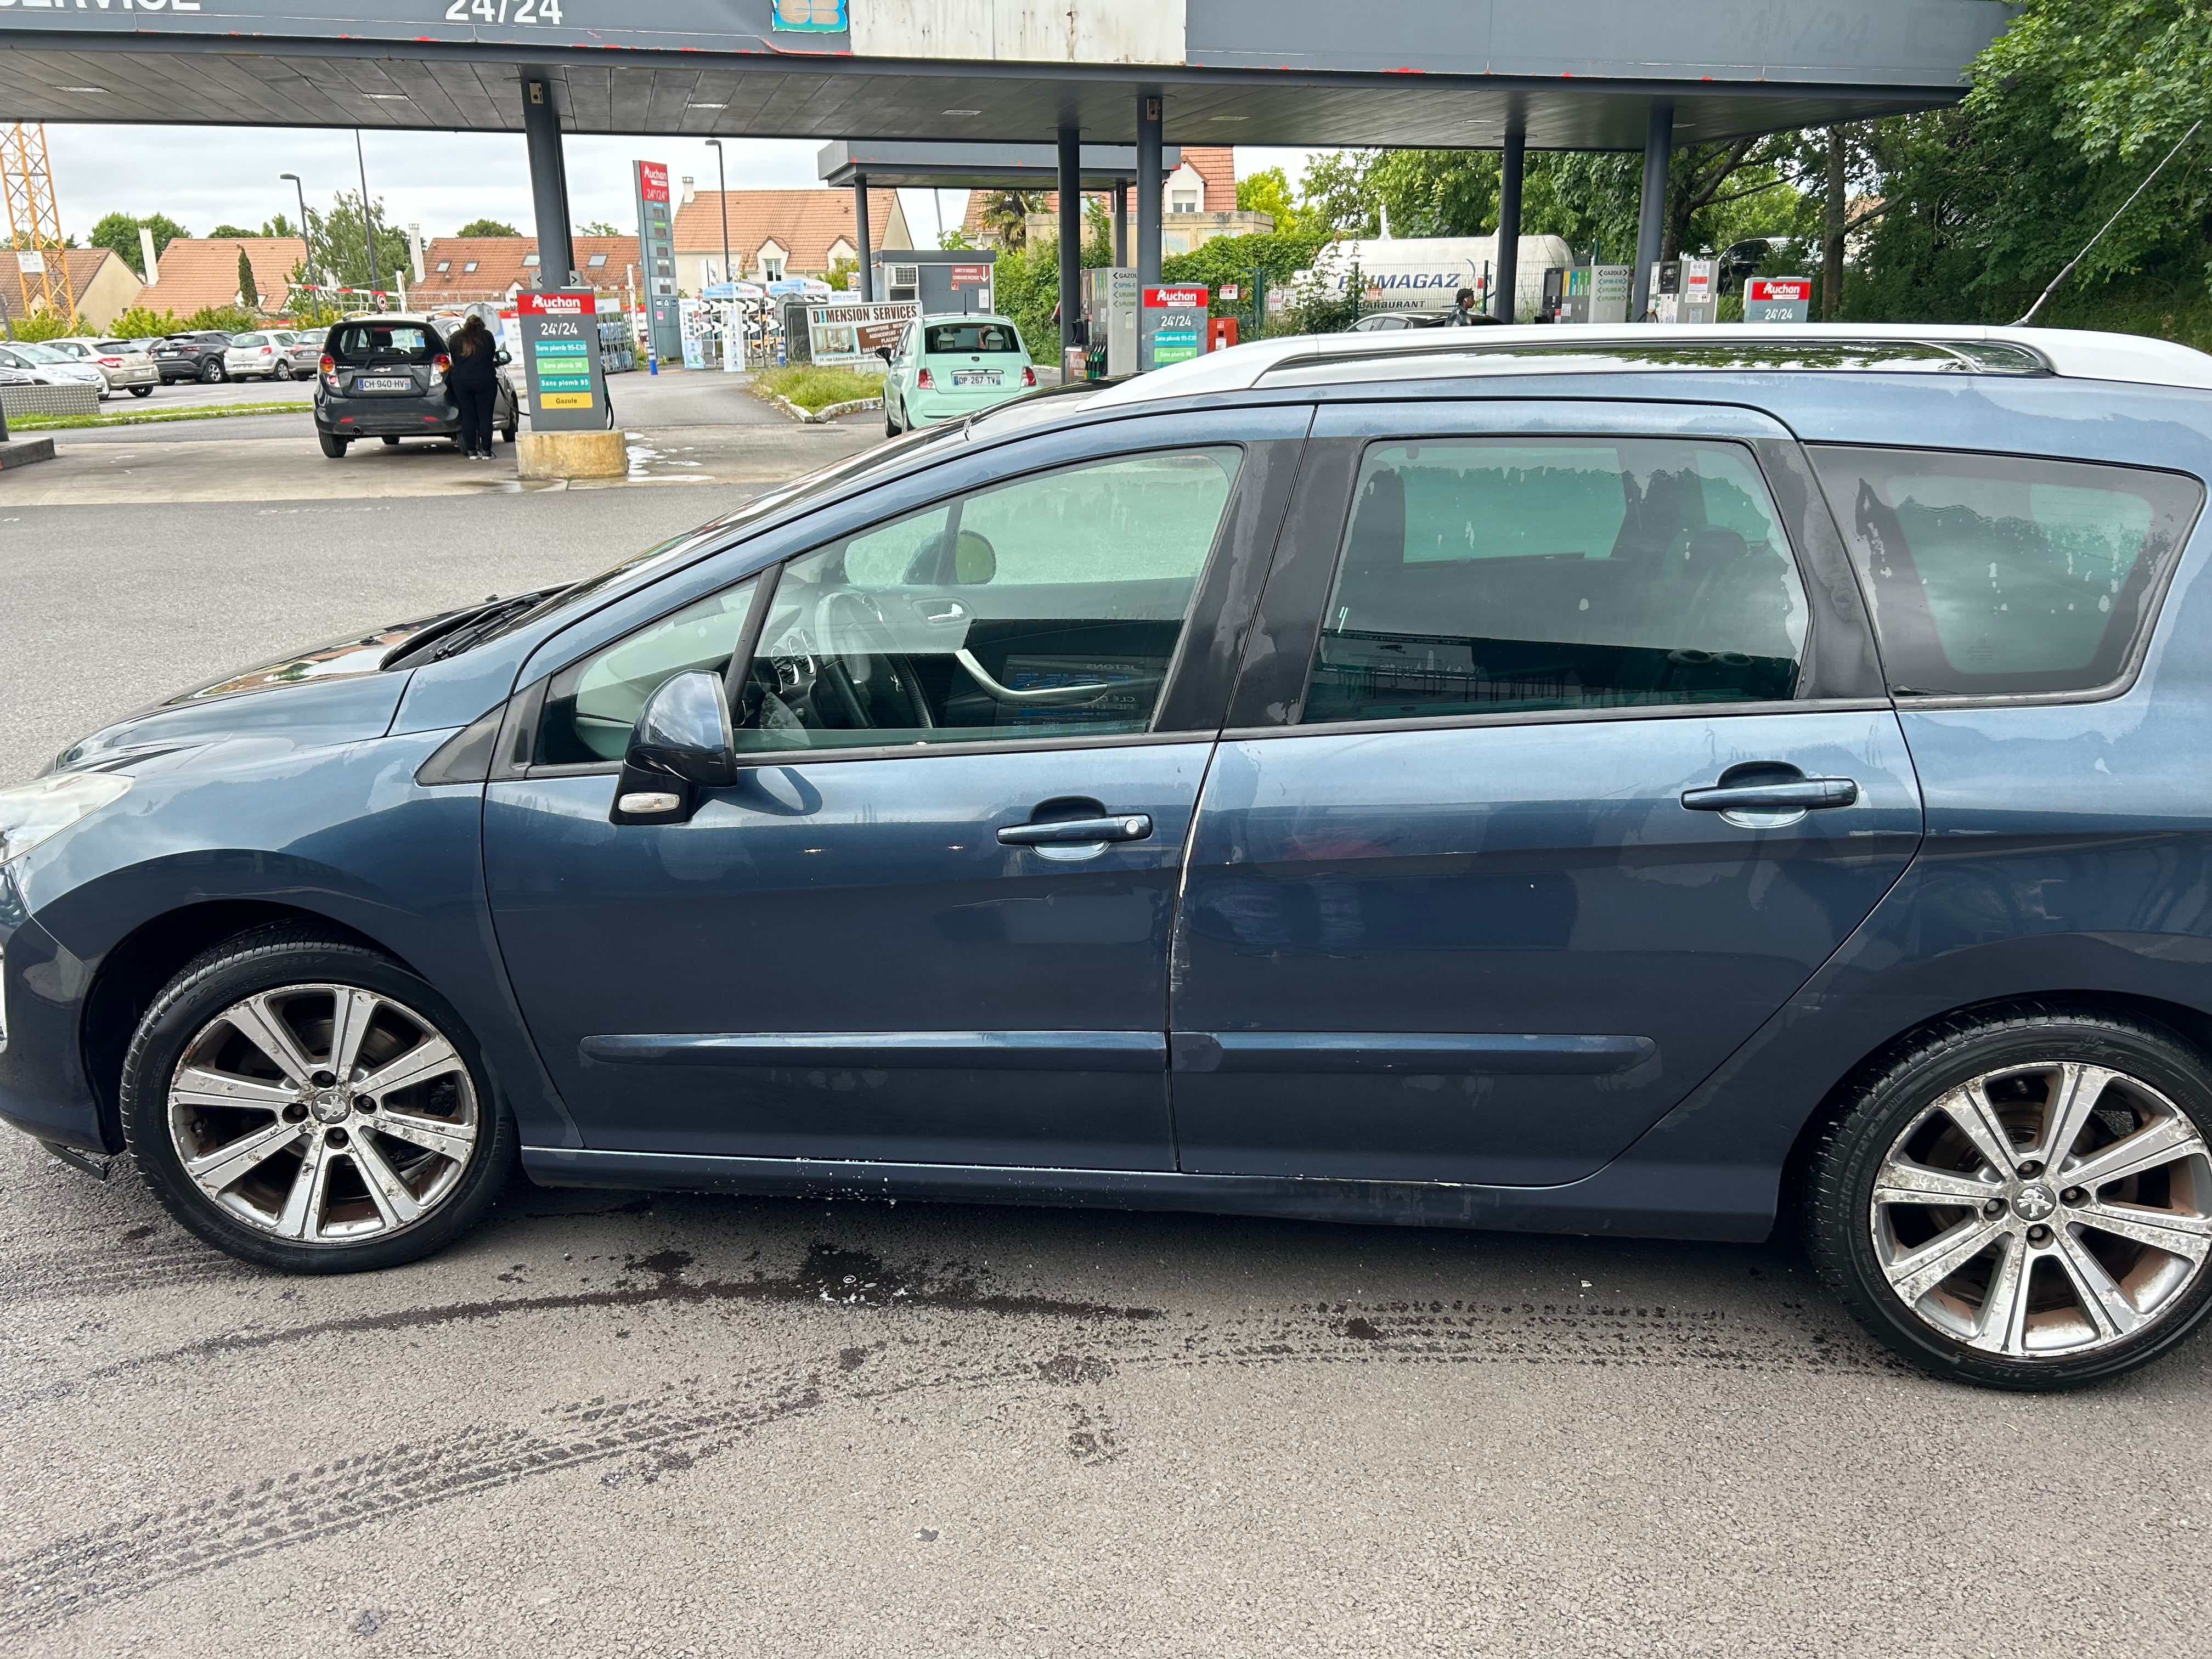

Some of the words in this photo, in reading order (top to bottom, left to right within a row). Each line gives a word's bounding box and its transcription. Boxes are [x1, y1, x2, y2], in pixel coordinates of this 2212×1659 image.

[644, 165, 667, 180] Auchan
[1763, 282, 1800, 294] Auchan
[532, 294, 581, 308] Auchan
[1156, 289, 1197, 301] Auchan
[873, 306, 916, 320] SERVICES
[558, 379, 579, 387] plomb
